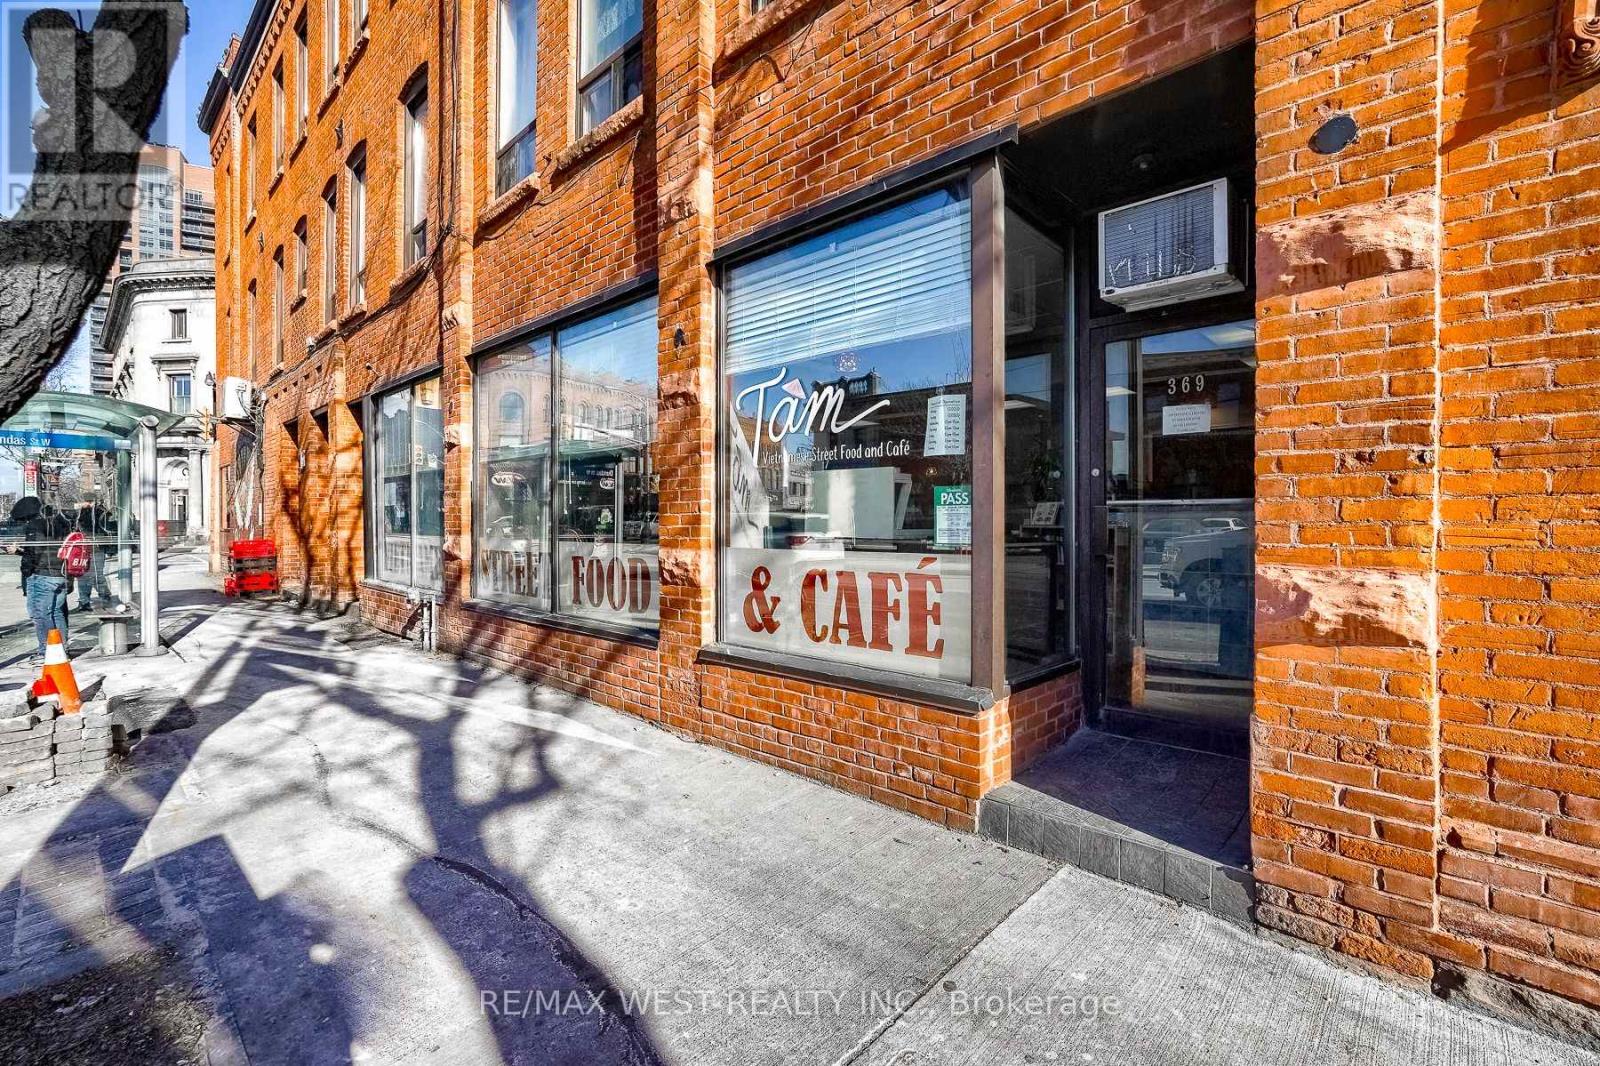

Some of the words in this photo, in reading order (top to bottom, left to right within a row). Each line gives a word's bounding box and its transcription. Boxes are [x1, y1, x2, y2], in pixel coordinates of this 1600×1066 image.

[1167, 374, 1205, 395] 369
[763, 450, 809, 465] Vietnmese
[811, 446, 838, 462] Street
[840, 444, 862, 459] Food
[864, 442, 884, 458] and
[886, 439, 910, 456] Café
[940, 492, 969, 505] PASS
[481, 549, 549, 598] STREE
[571, 555, 651, 613] FOOD
[742, 565, 781, 634] &
[801, 557, 944, 659] CAFÉ
